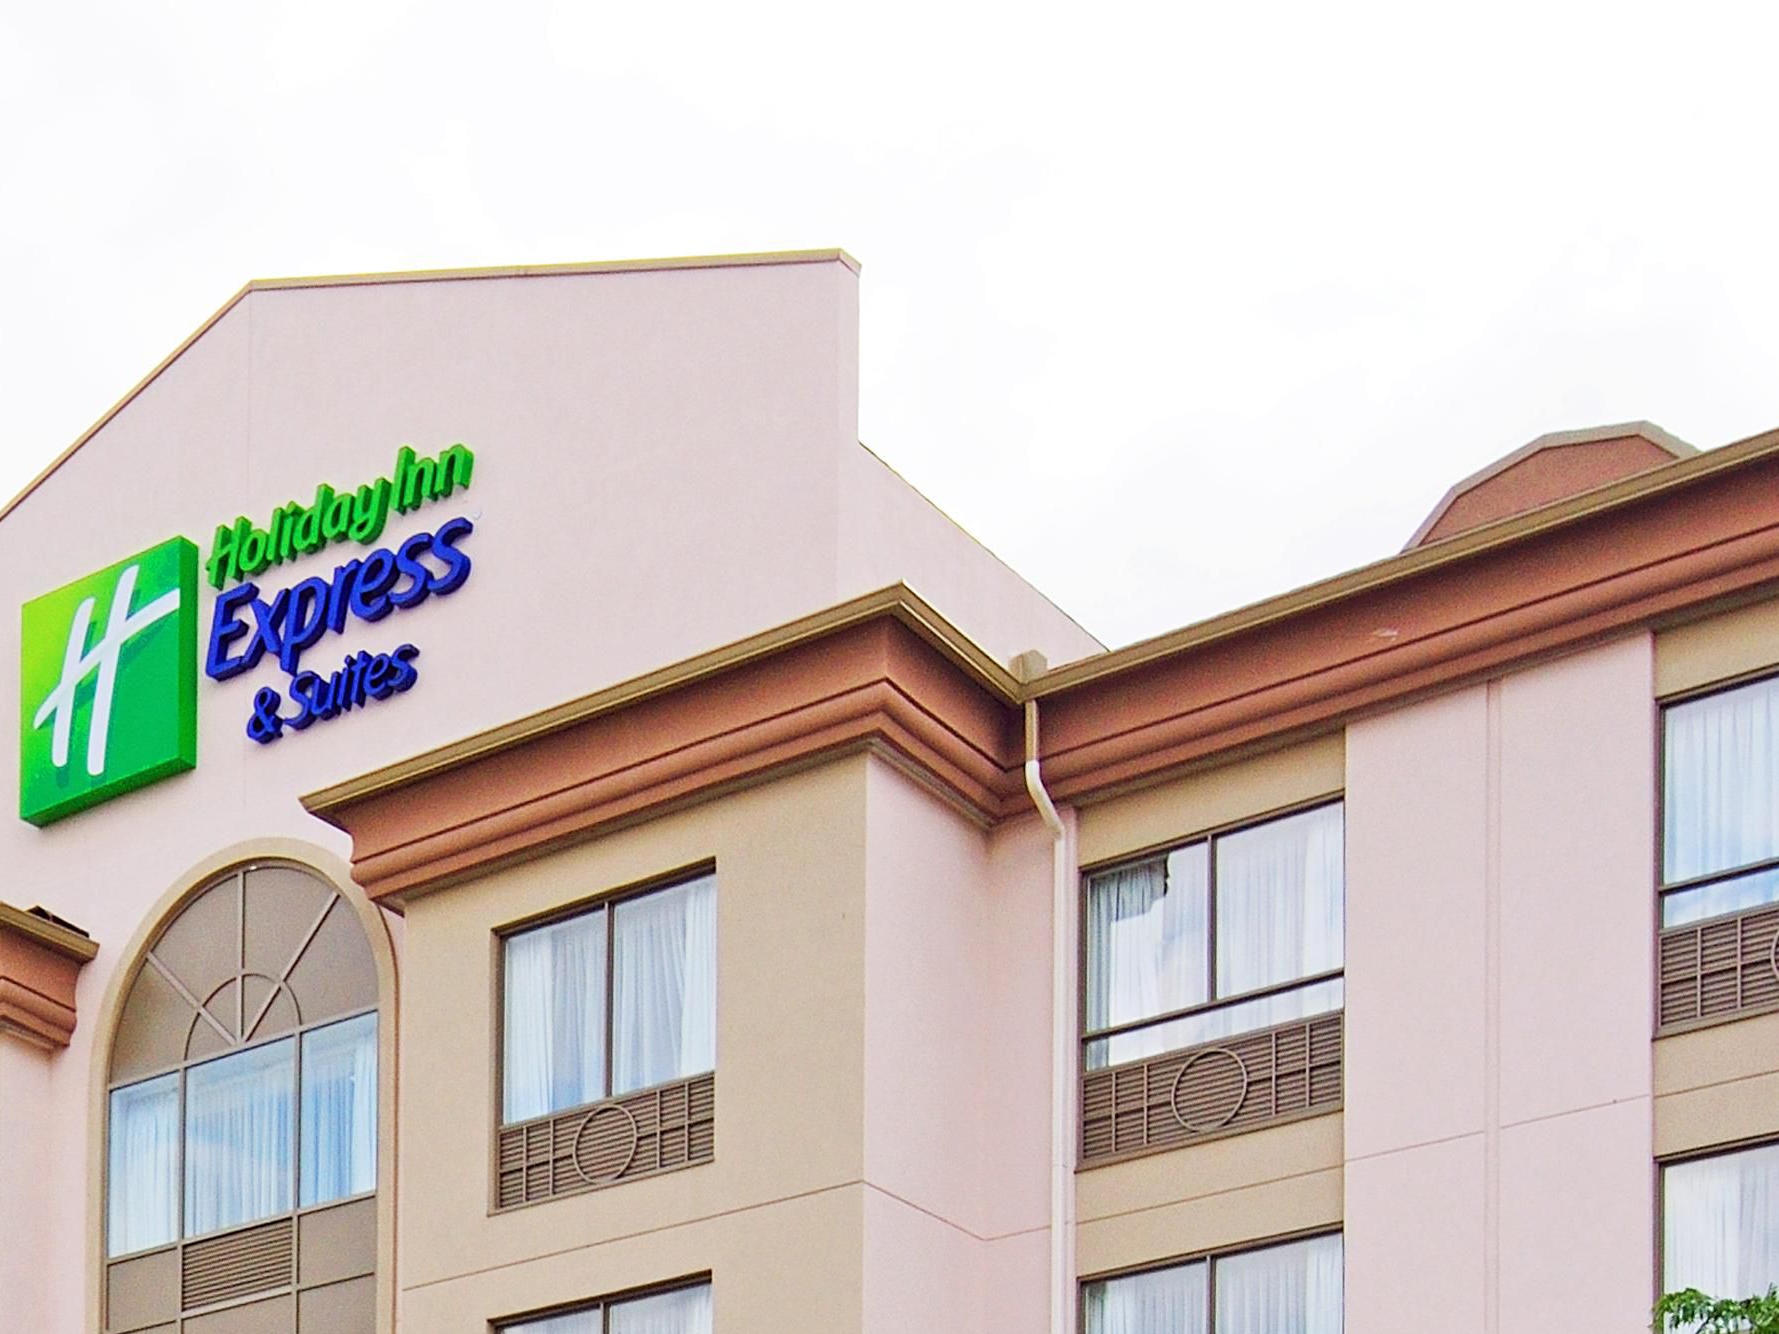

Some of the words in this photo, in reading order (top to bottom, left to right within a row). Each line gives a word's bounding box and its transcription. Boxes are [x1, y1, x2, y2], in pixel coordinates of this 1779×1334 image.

[205, 476, 392, 590] Holiday
[391, 444, 475, 514] Inn
[205, 517, 474, 682] Express
[245, 686, 283, 744] &
[283, 643, 419, 730] Suites
